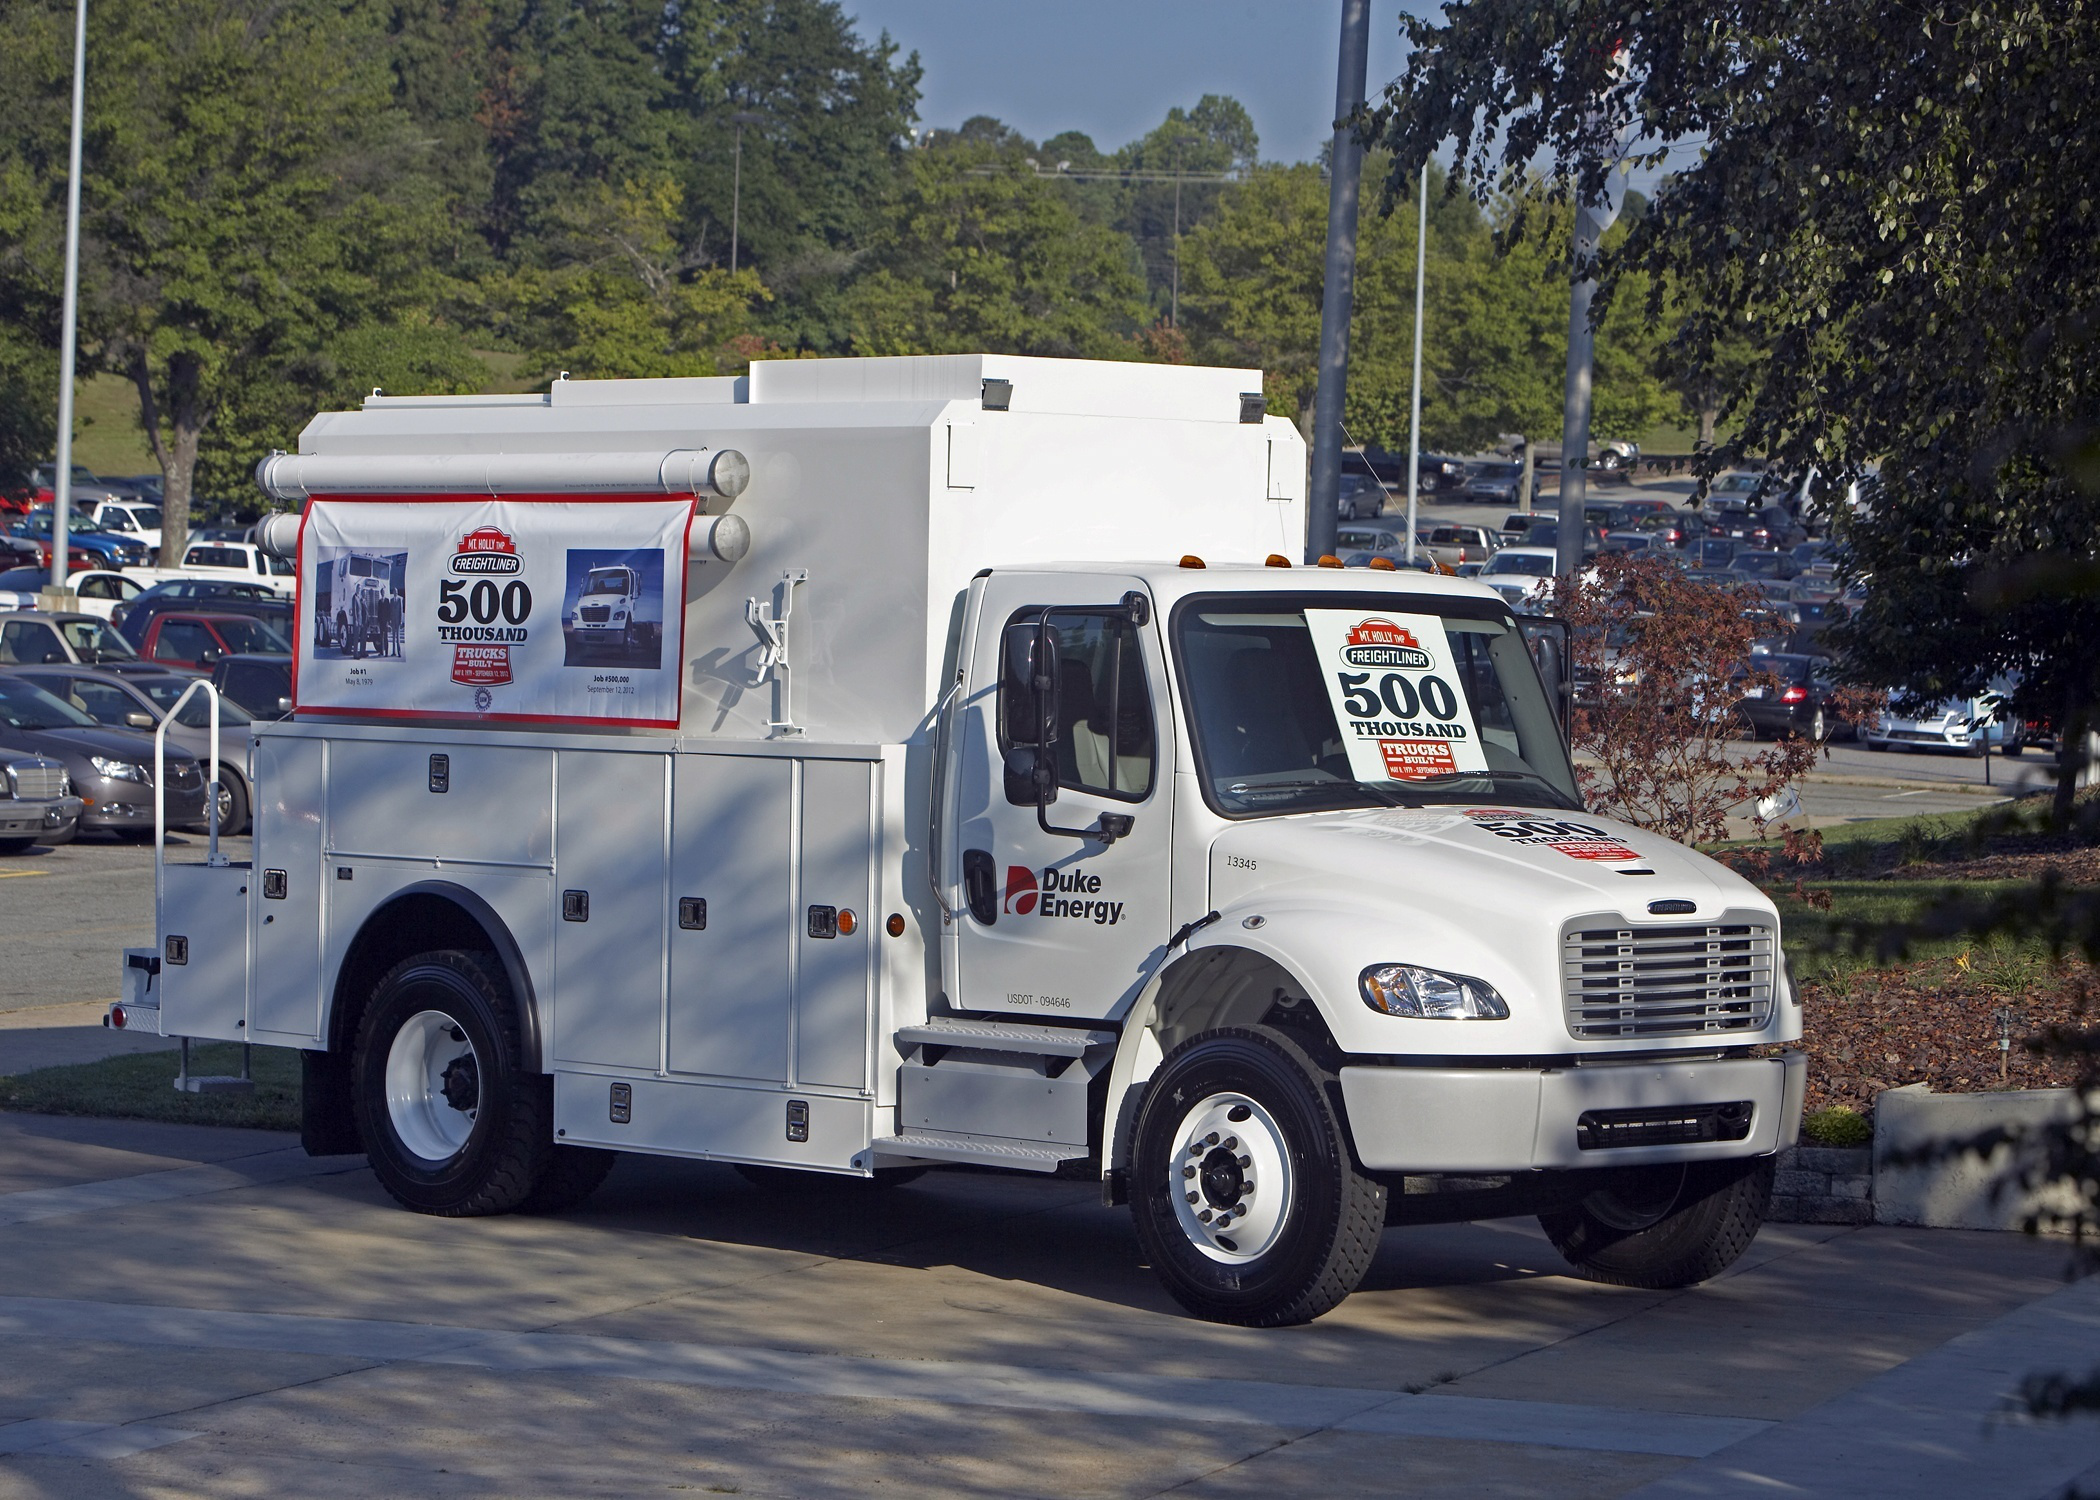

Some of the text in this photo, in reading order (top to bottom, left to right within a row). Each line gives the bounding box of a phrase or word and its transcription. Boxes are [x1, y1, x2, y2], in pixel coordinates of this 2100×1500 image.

[467, 538, 477, 550] MT.
[478, 538, 496, 550] HOLLY
[454, 557, 517, 571] FREIGHTLINER
[437, 579, 532, 625] 500
[437, 626, 528, 642] THOUSAND
[1358, 630, 1405, 644] MT. HOLLY TMP
[457, 647, 507, 659] TRUCKS
[1350, 649, 1426, 666] FREIGHTLINER
[468, 660, 493, 668] BUILT
[345, 678, 356, 686] May
[605, 675, 630, 683] #500,000
[587, 685, 614, 694] September
[622, 686, 635, 694] 2012
[1337, 672, 1458, 721] 500
[1349, 721, 1467, 738] THOUSAND
[1382, 743, 1449, 756] TRUCKS
[1403, 756, 1435, 764] BUILT
[1472, 821, 1608, 838] 500
[1509, 835, 1630, 845] THOUSAND
[1227, 855, 1257, 870] 13345
[1042, 867, 1102, 894] Duke
[1007, 993, 1033, 1005] USDOT
[1039, 995, 1071, 1009] 094646
